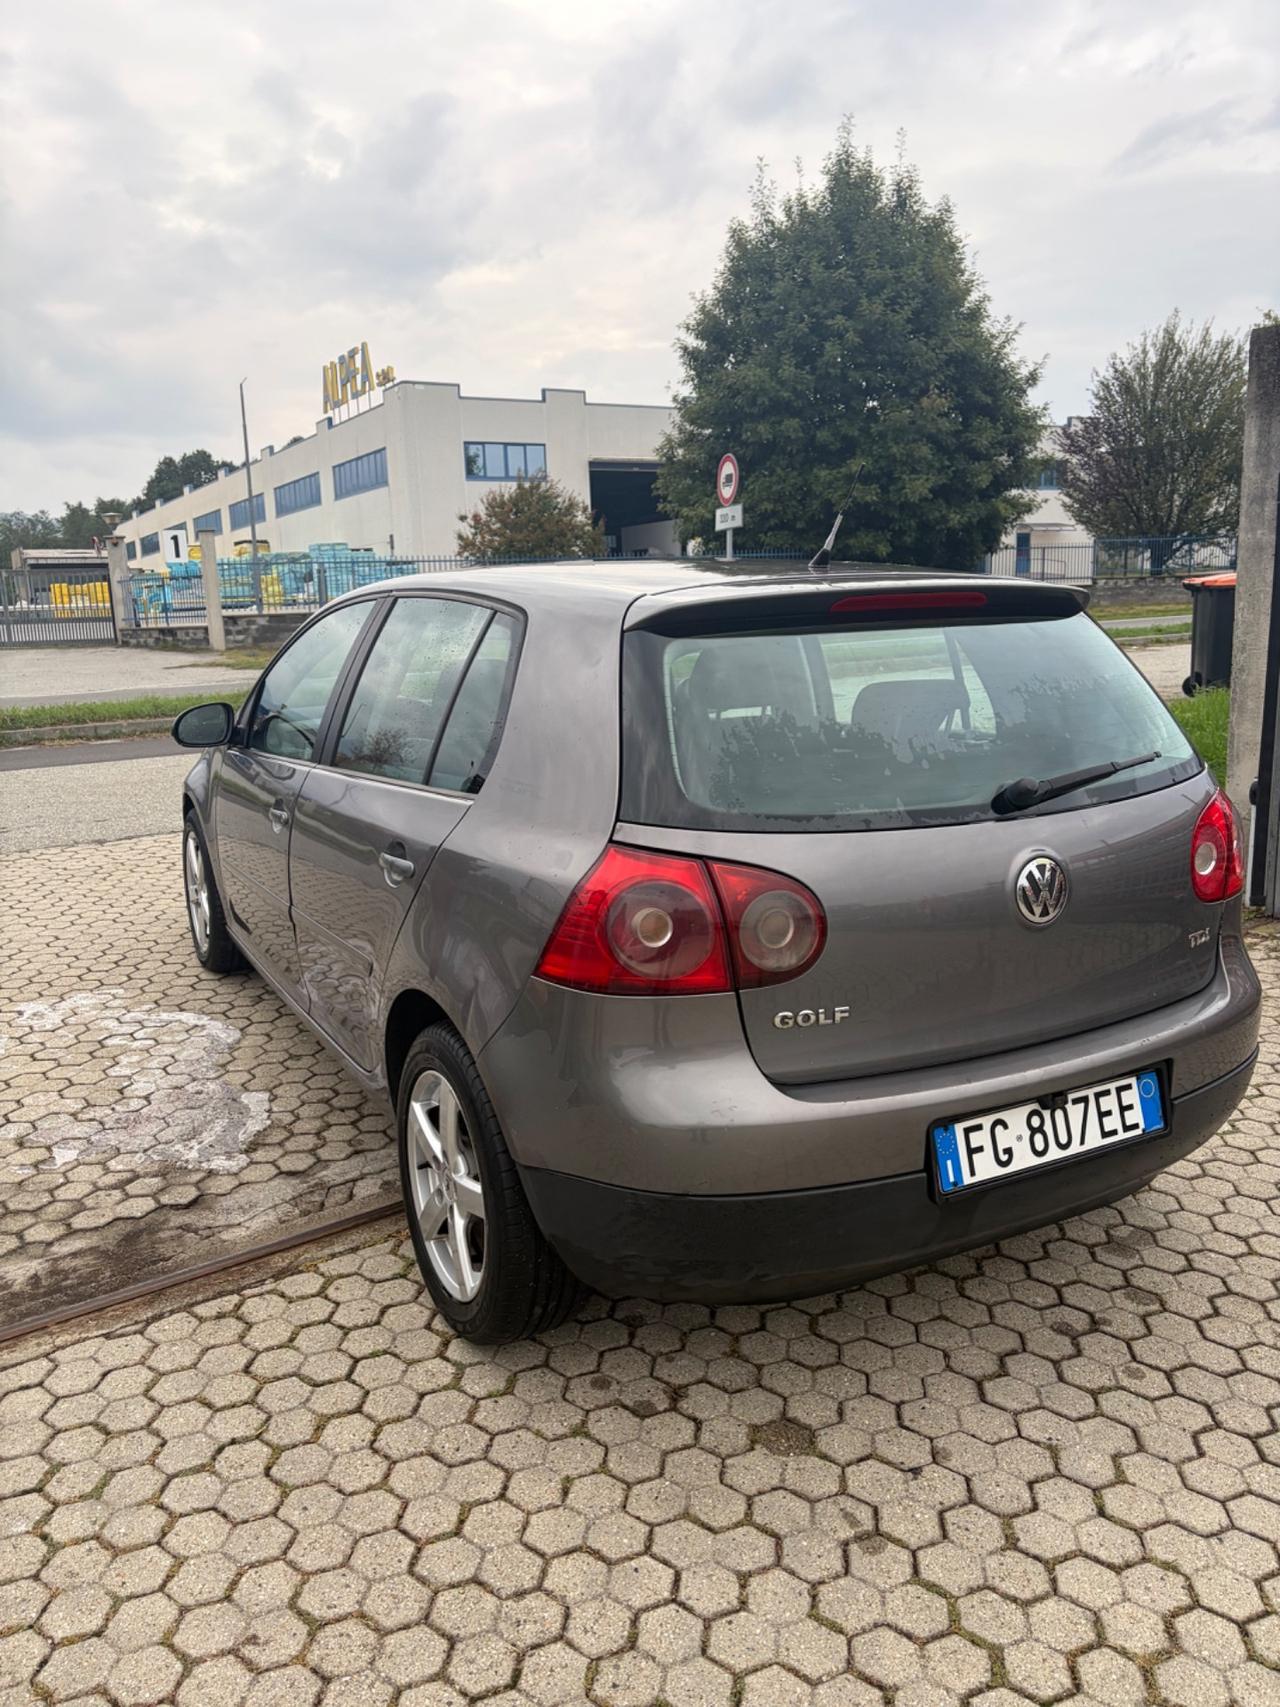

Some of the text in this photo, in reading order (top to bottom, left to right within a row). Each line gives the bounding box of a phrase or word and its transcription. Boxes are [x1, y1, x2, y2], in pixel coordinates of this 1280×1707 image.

[322, 341, 375, 414] ALPEA
[170, 534, 180, 558] 1
[774, 1006, 850, 1029] GOLF
[962, 1083, 1140, 1178] FG 807EE
